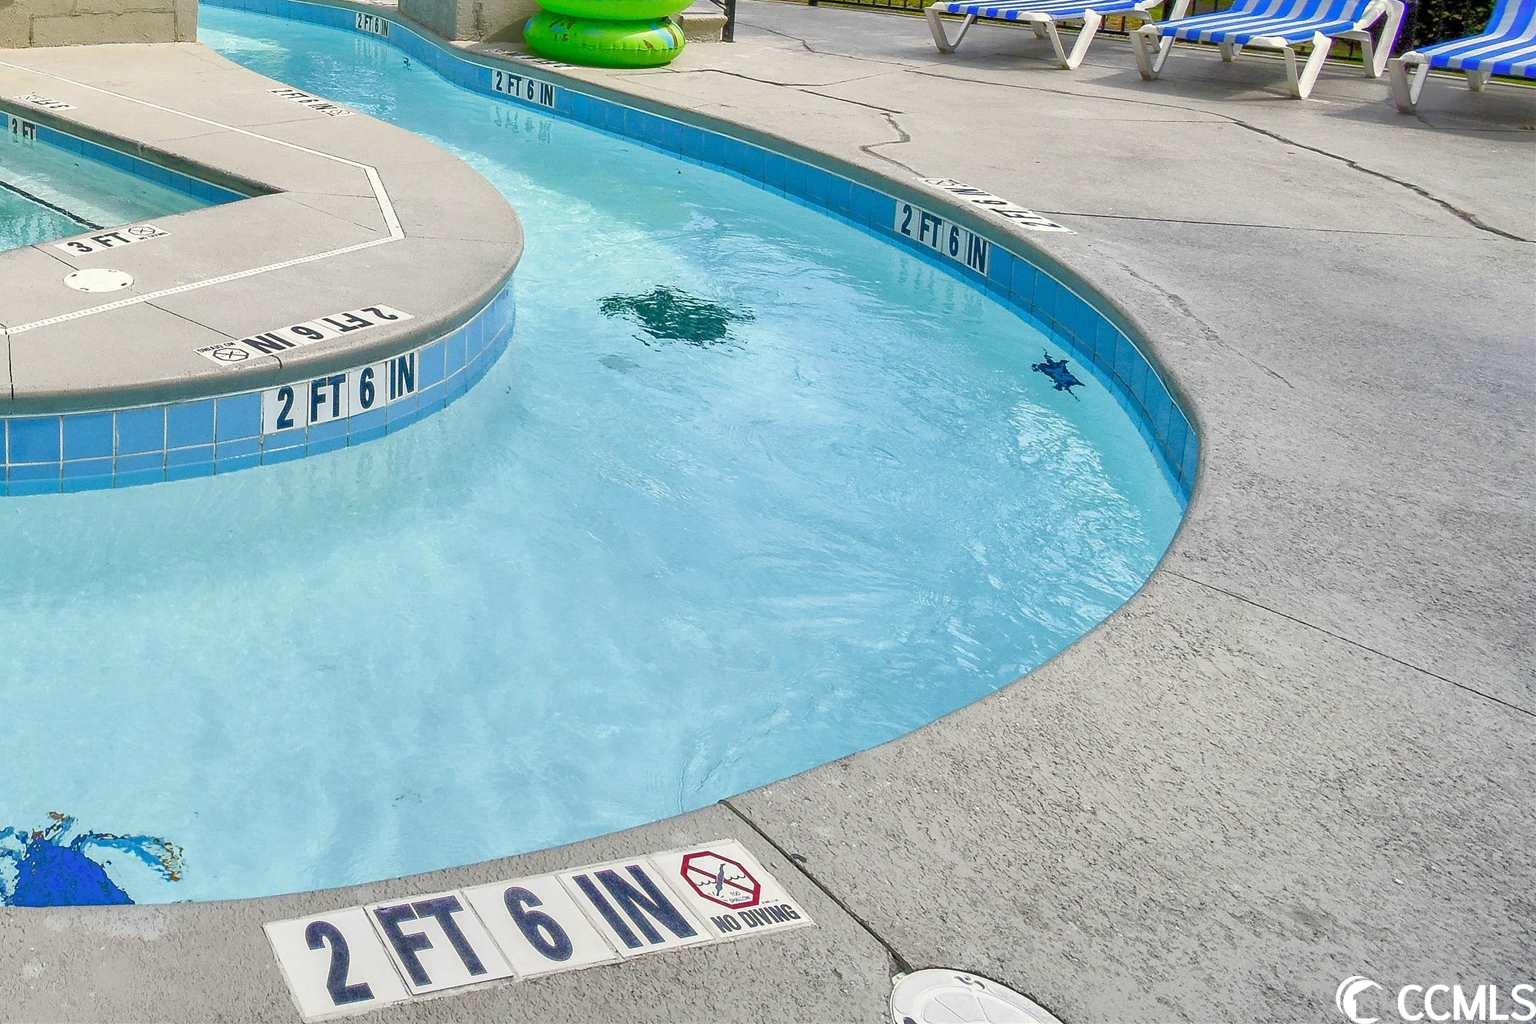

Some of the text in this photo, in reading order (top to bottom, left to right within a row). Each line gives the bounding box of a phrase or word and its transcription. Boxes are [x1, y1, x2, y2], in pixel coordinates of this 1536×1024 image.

[364, 14, 373, 32] FT
[374, 17, 379, 33] 6
[381, 19, 389, 37] IN
[496, 70, 553, 107] 2 FT 6 IN
[66, 241, 94, 254] 3
[90, 231, 132, 248] FT
[901, 204, 988, 274] 2 FT 6 IN
[239, 307, 400, 354] 2 FT 6 IN
[276, 351, 415, 430] 2 FT 6 IN
[304, 863, 700, 1007] 2 FT 6 IN
[710, 903, 802, 934] NO DIVING
